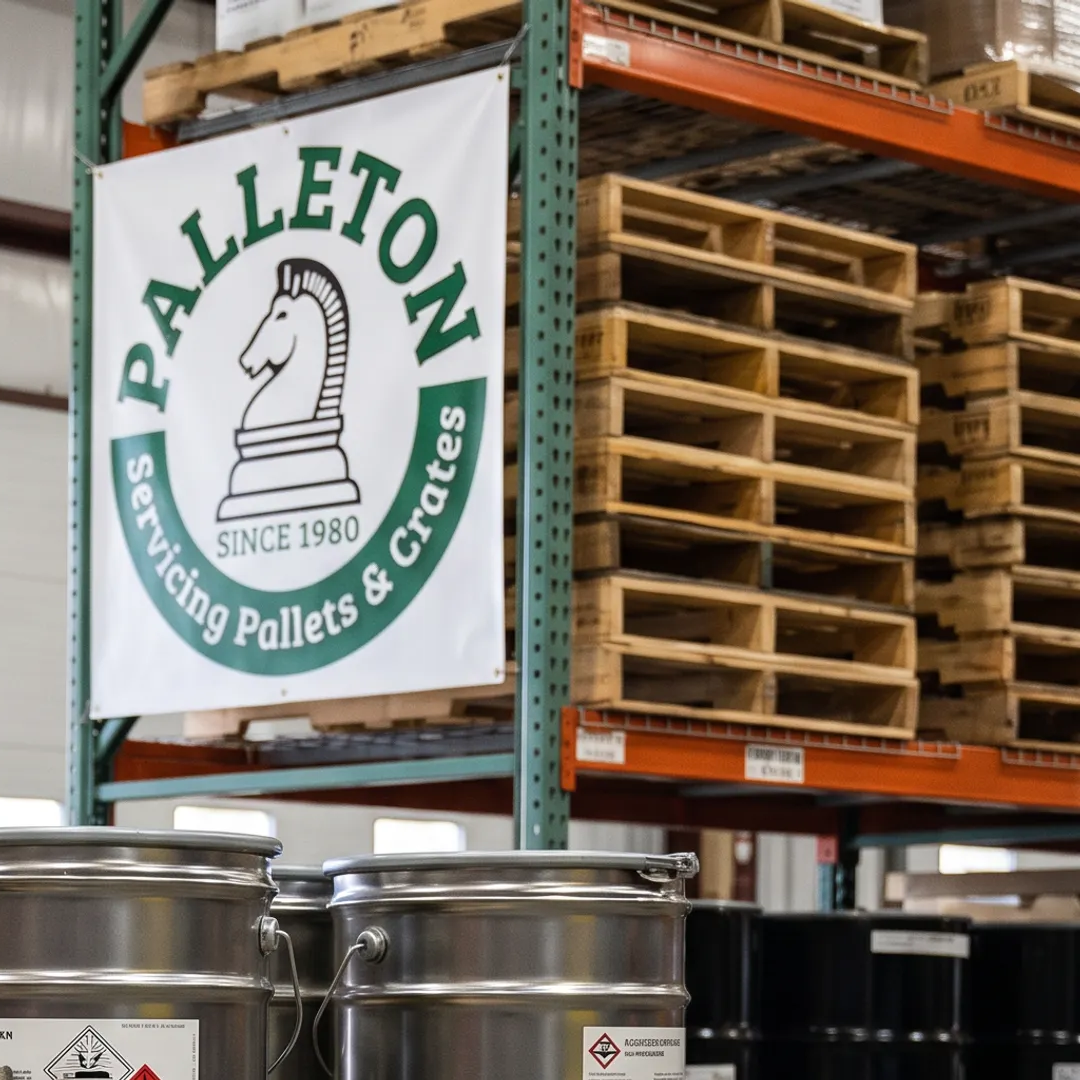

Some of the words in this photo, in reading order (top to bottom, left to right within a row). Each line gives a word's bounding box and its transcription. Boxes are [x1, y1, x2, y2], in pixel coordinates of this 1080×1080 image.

[118, 146, 481, 412] PALLETON
[126, 452, 227, 646] Servicing
[234, 598, 358, 652] Pallets
[363, 561, 394, 605] &
[388, 405, 466, 565] Crates
[217, 522, 291, 559] SINCE
[299, 514, 360, 548] 1980
